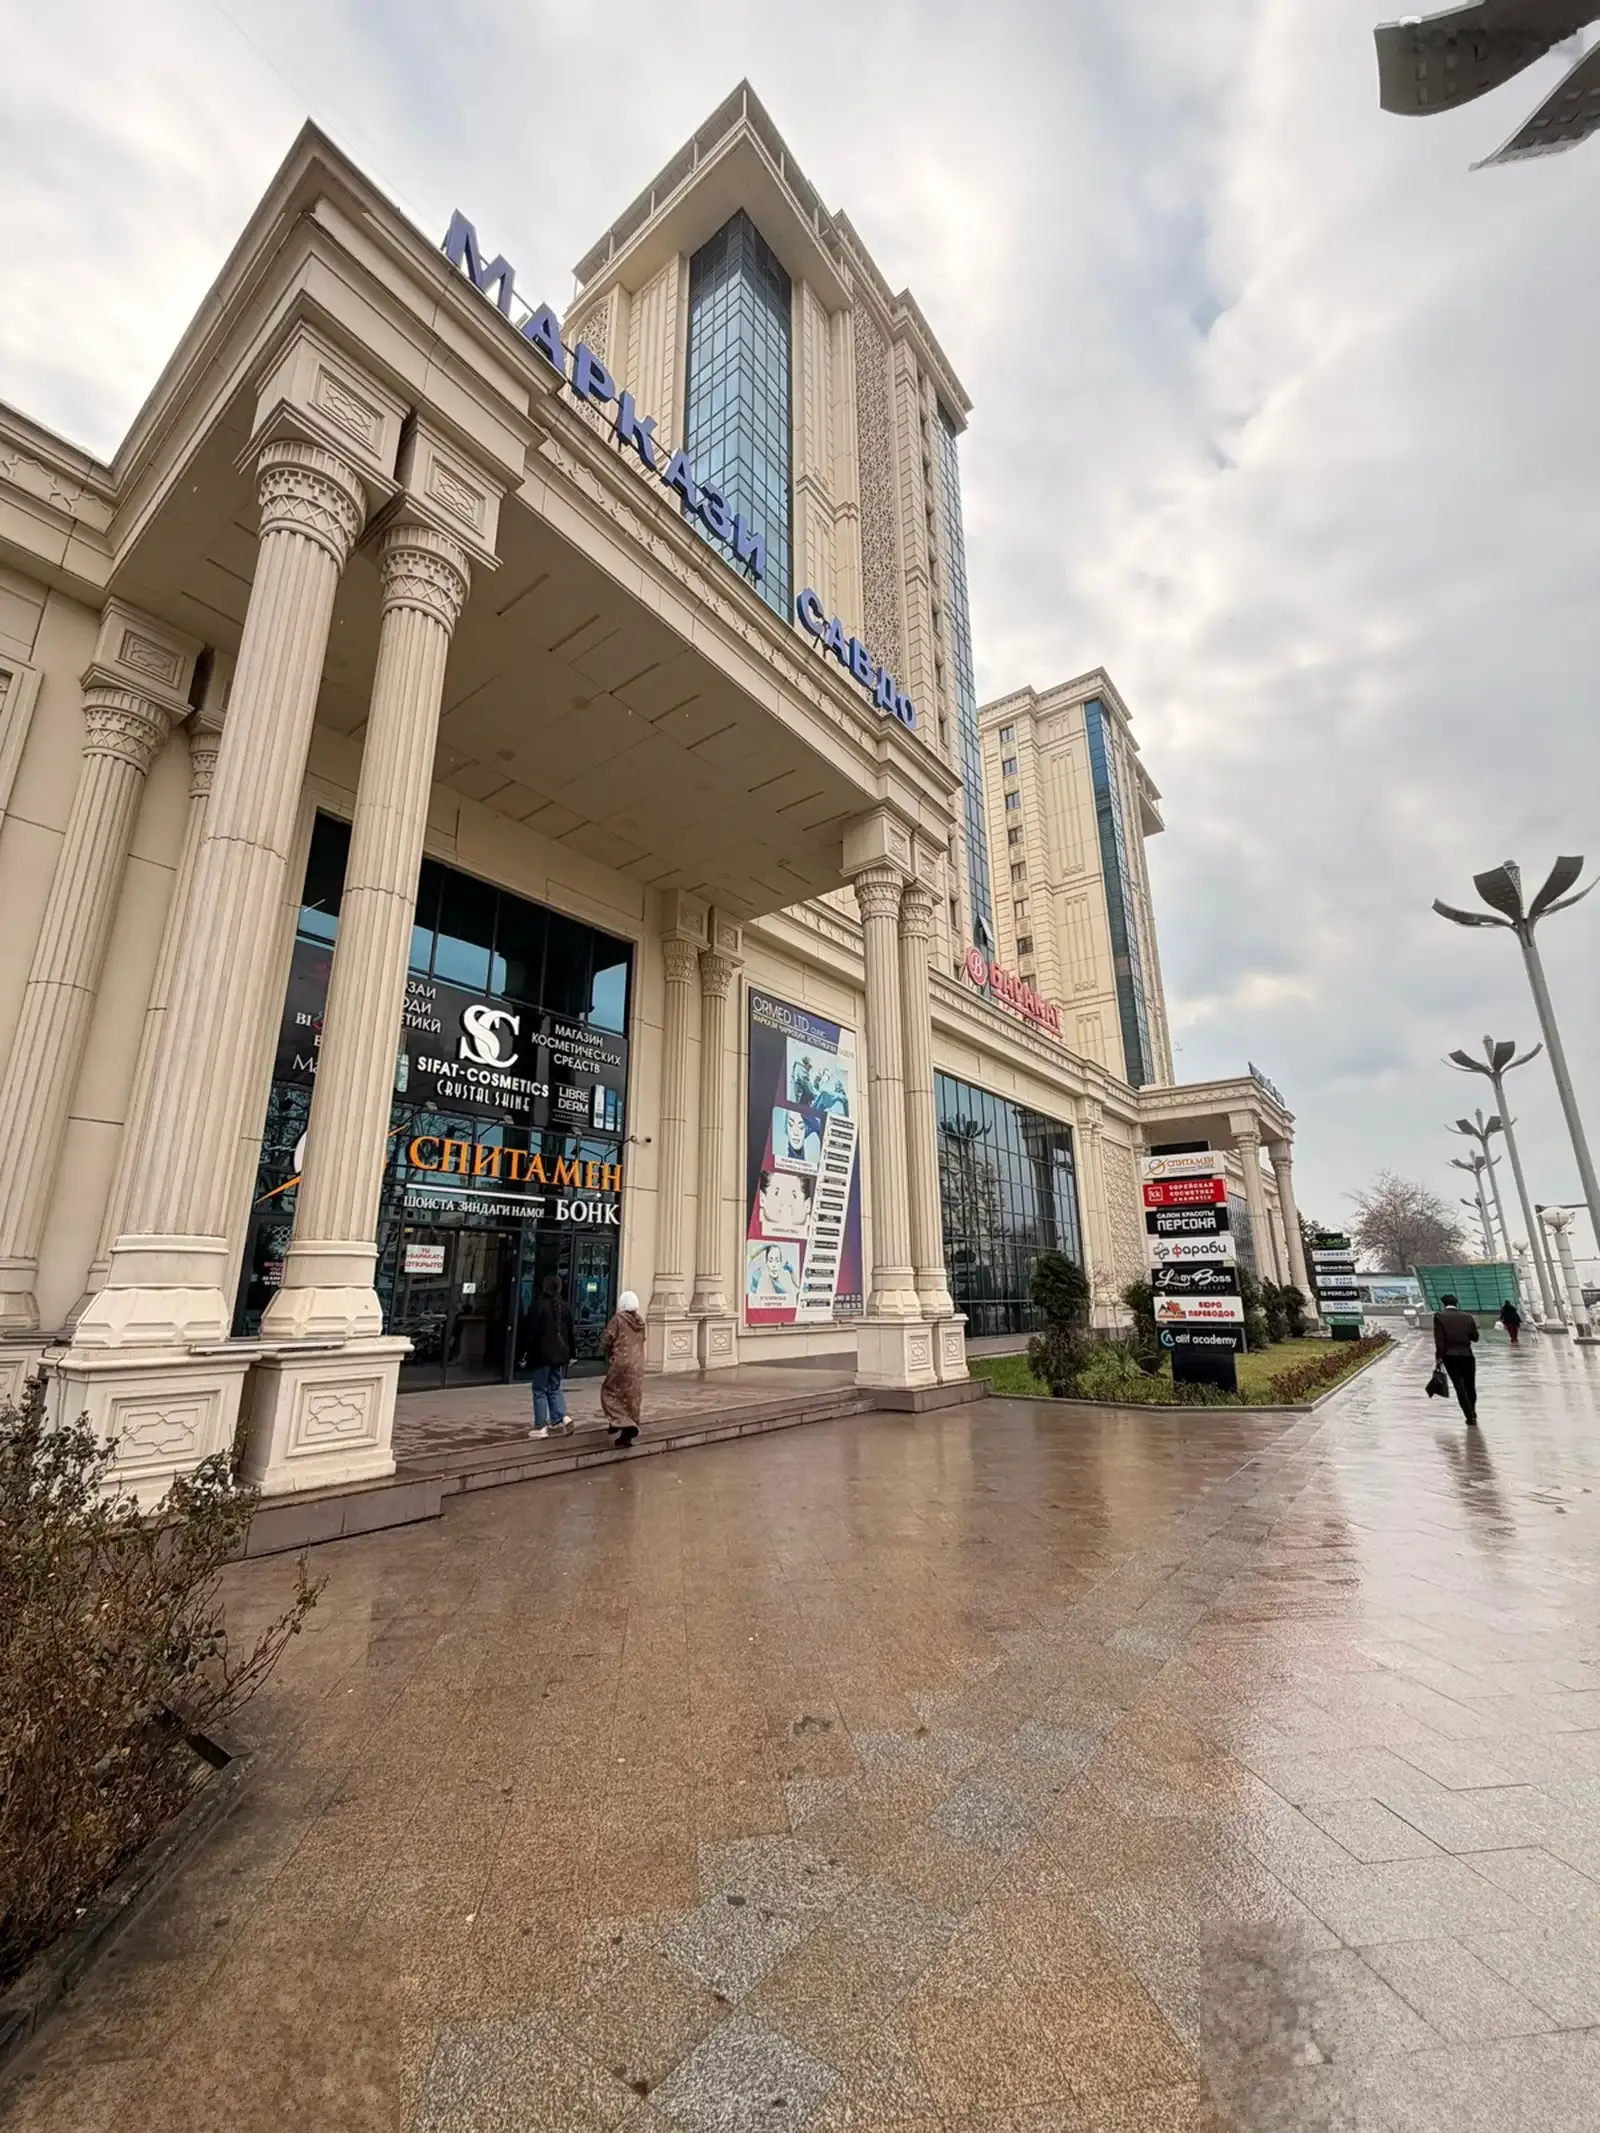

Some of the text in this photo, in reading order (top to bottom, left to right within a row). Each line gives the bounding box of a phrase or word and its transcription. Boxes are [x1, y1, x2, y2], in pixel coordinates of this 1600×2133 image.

[441, 208, 916, 730] МАРКАЗИ САВДО
[404, 981, 437, 1000] ЗАИ
[752, 996, 792, 1024] ORMED
[793, 1013, 809, 1032] LTD
[555, 1023, 604, 1048] МАГАЗИН
[531, 1032, 622, 1066] КОСМЕТИЧЕСКИХ
[553, 1052, 601, 1074] СРЕДСТВ
[417, 1056, 550, 1098] SIFAT-COSMETICS
[436, 1079, 531, 1113] CRYSTAL SHINE
[558, 1086, 589, 1101] LIBRE
[557, 1098, 589, 1113] DERM
[410, 1136, 623, 1192] СПИТАМЕН
[1169, 1189, 1215, 1197] КОСМЕТИКА
[457, 1200, 510, 1216] ЗИНДАГИ
[555, 1199, 620, 1225] БОНК
[1182, 1210, 1215, 1218] КРАСОТЫ
[1157, 1217, 1217, 1231] ПЕРСОНА
[1172, 1241, 1227, 1258] фараби
[1192, 1334, 1237, 1348] academy
